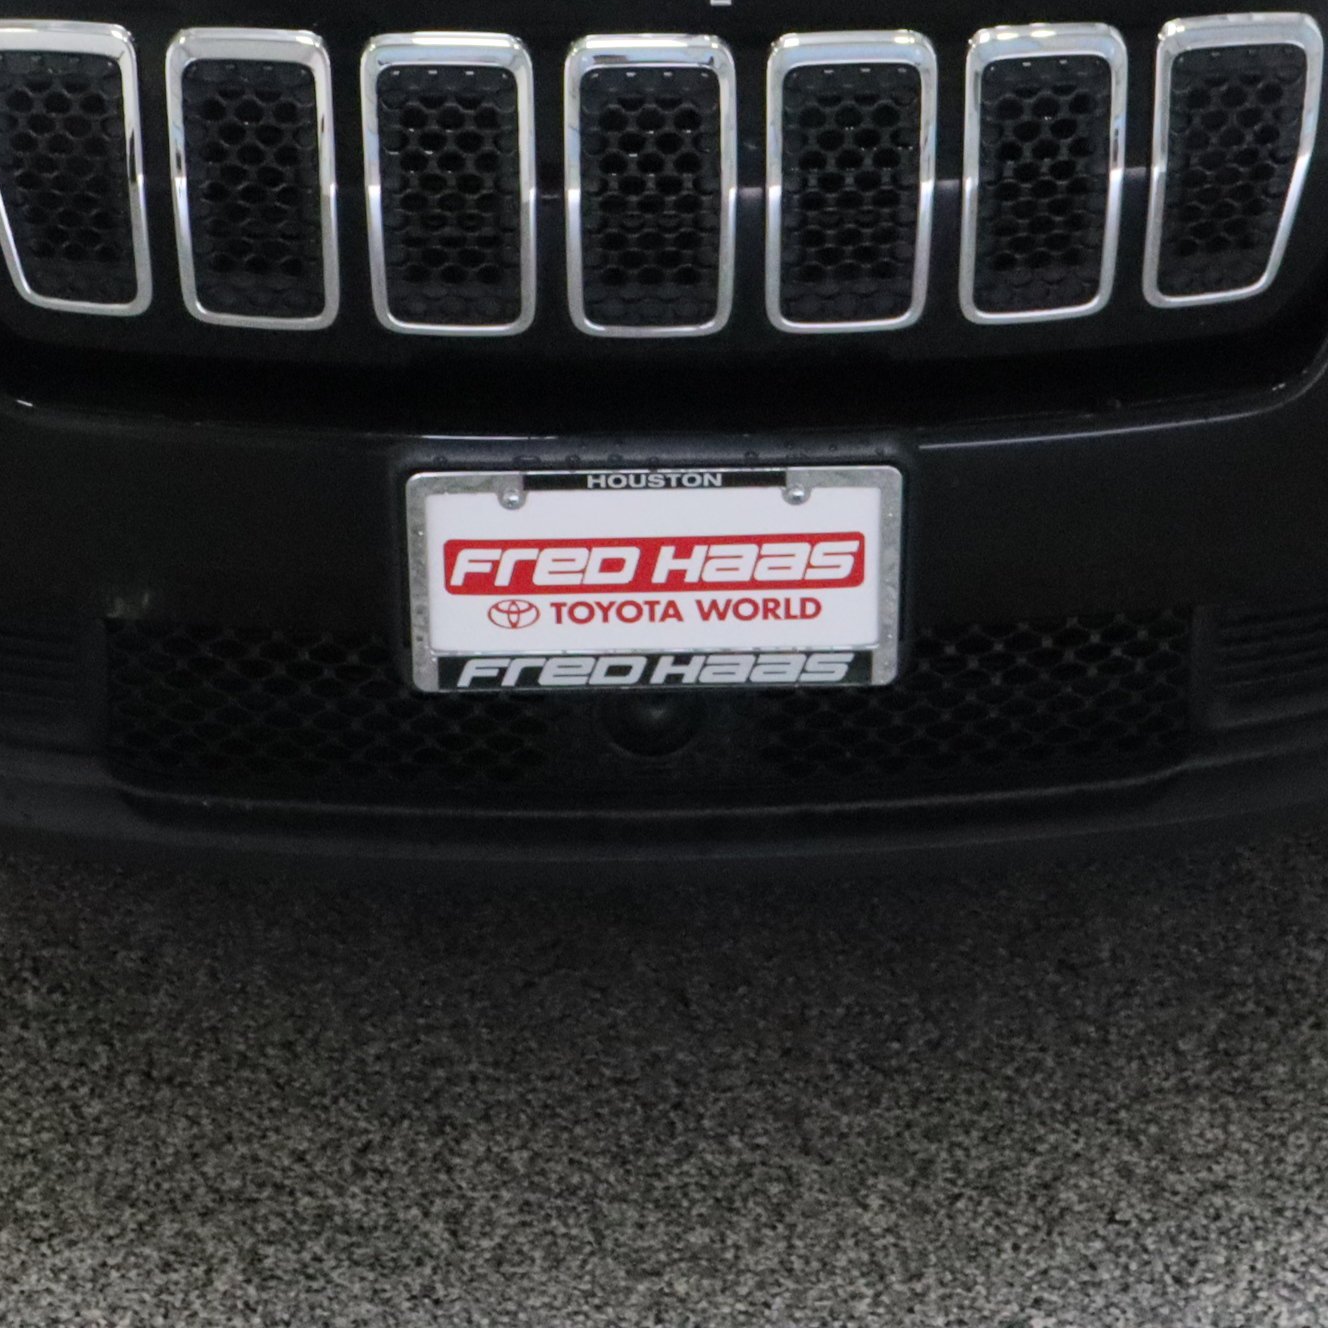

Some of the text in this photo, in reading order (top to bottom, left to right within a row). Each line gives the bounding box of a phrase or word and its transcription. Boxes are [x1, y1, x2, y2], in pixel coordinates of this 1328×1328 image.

[586, 472, 723, 489] HOUSTON
[550, 597, 822, 625] TOYOTA WORLD
